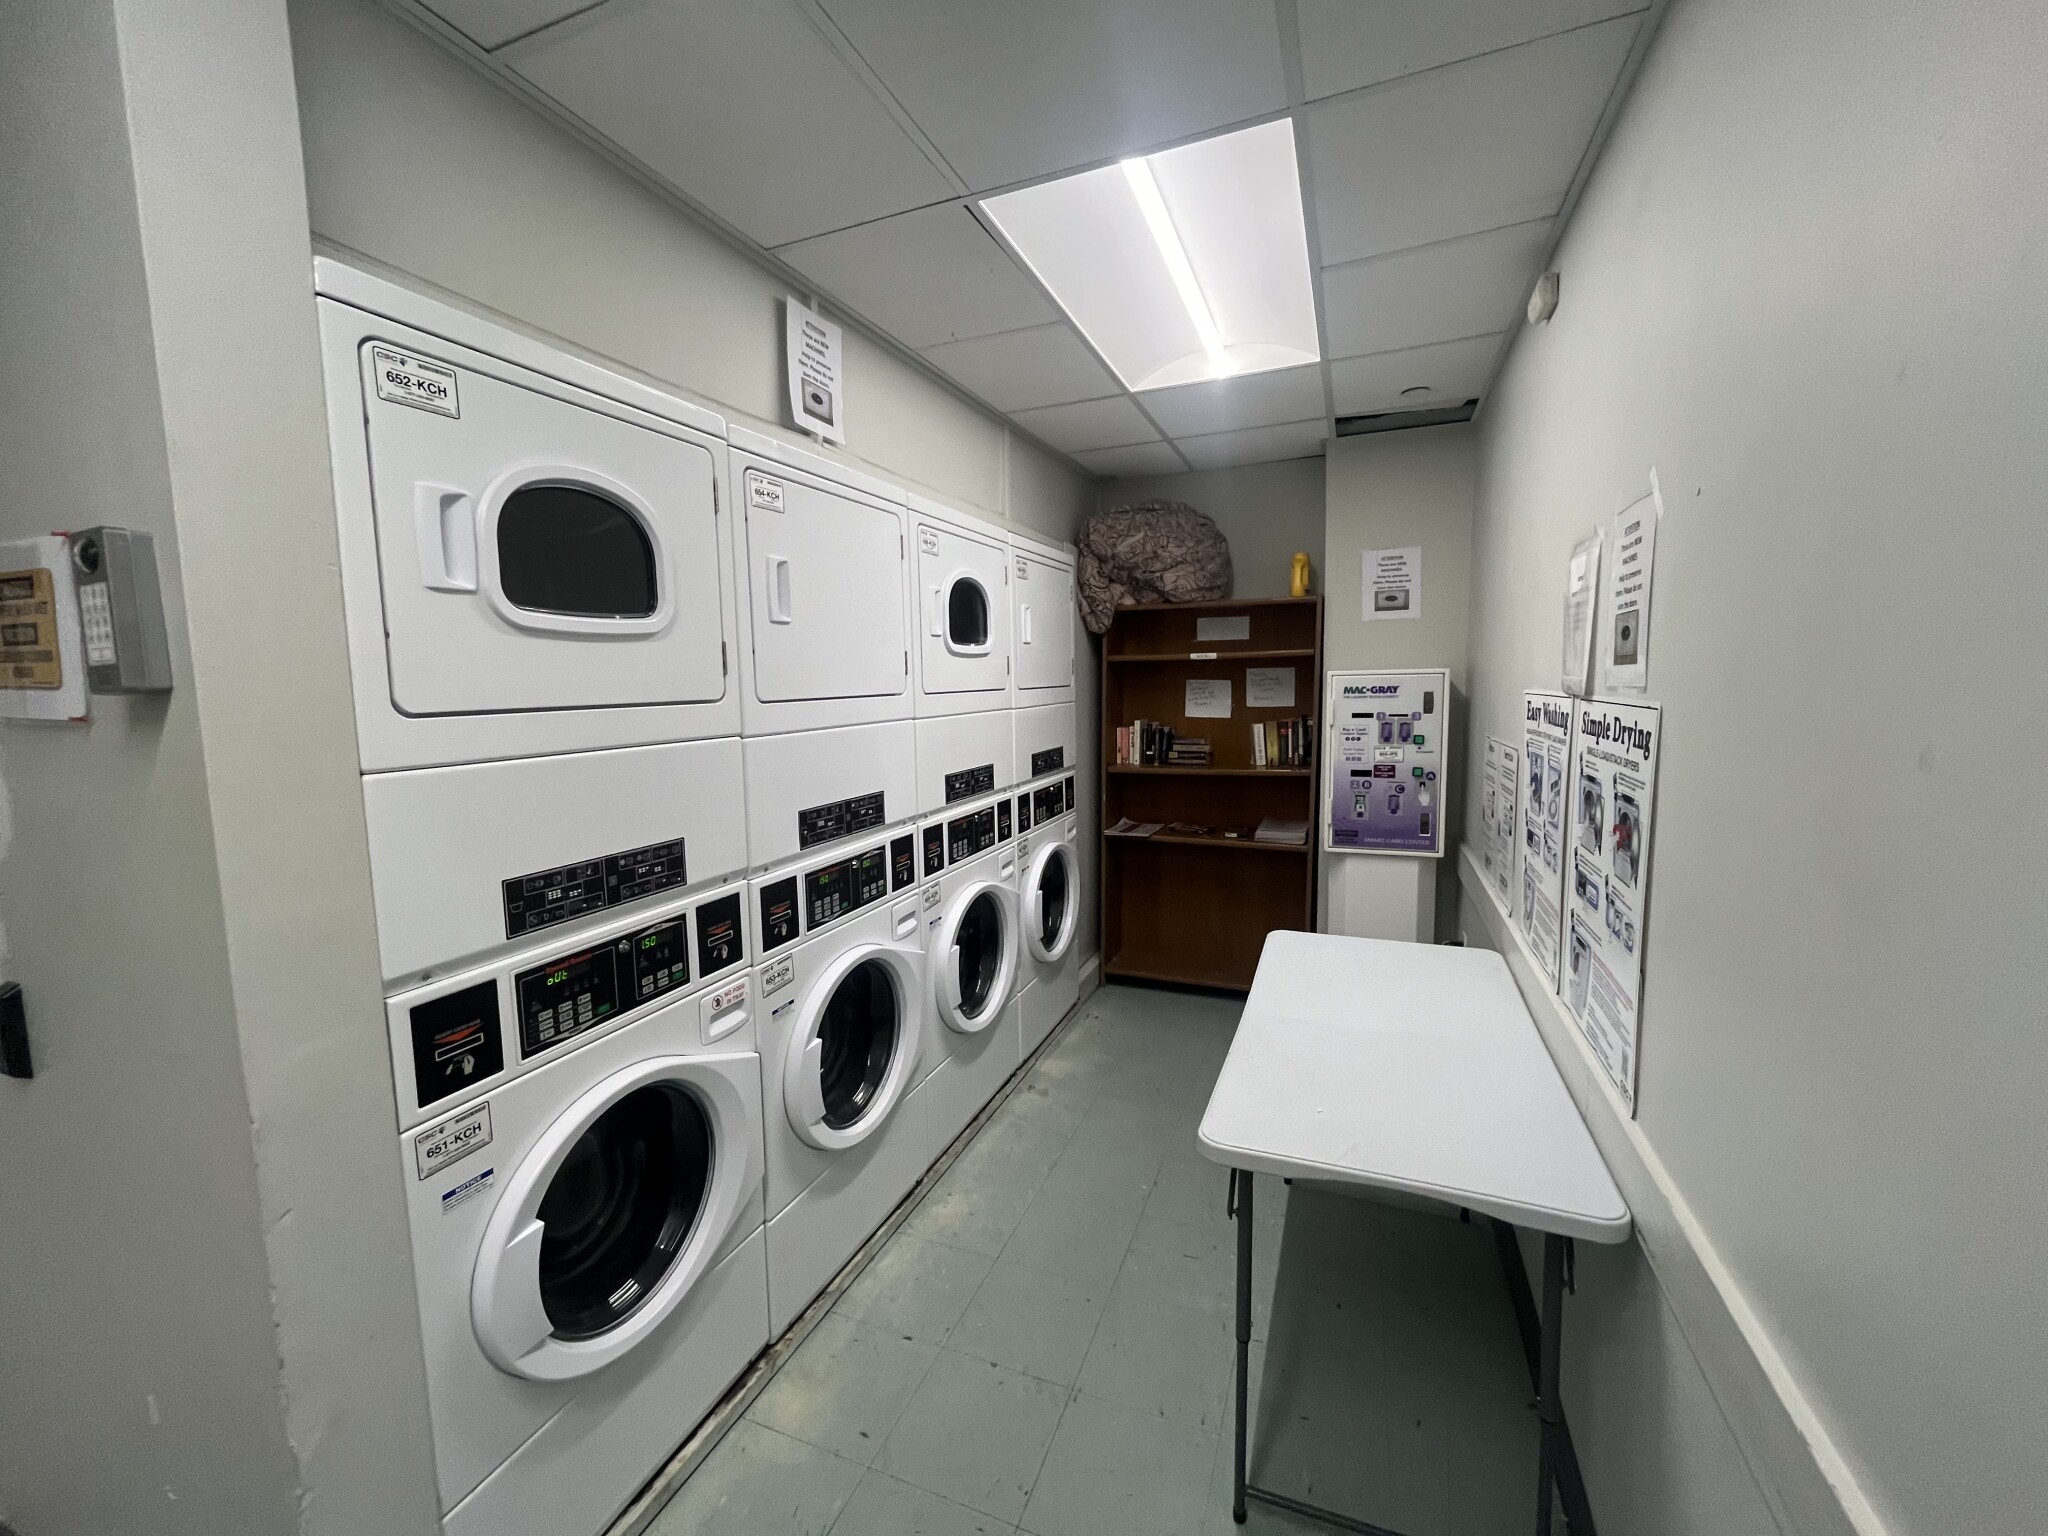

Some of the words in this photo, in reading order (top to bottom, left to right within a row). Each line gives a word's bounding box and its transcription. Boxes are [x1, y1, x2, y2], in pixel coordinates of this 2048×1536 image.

[386, 370, 447, 398] 652-KCH
[1527, 701, 1542, 728] Easy
[1543, 702, 1569, 736] Washing
[1582, 711, 1610, 745] Simple
[1612, 716, 1651, 760] Drying
[733, 983, 745, 993] PODS
[426, 1122, 481, 1158] 651-KCH
[455, 1175, 481, 1193] NOTICE
